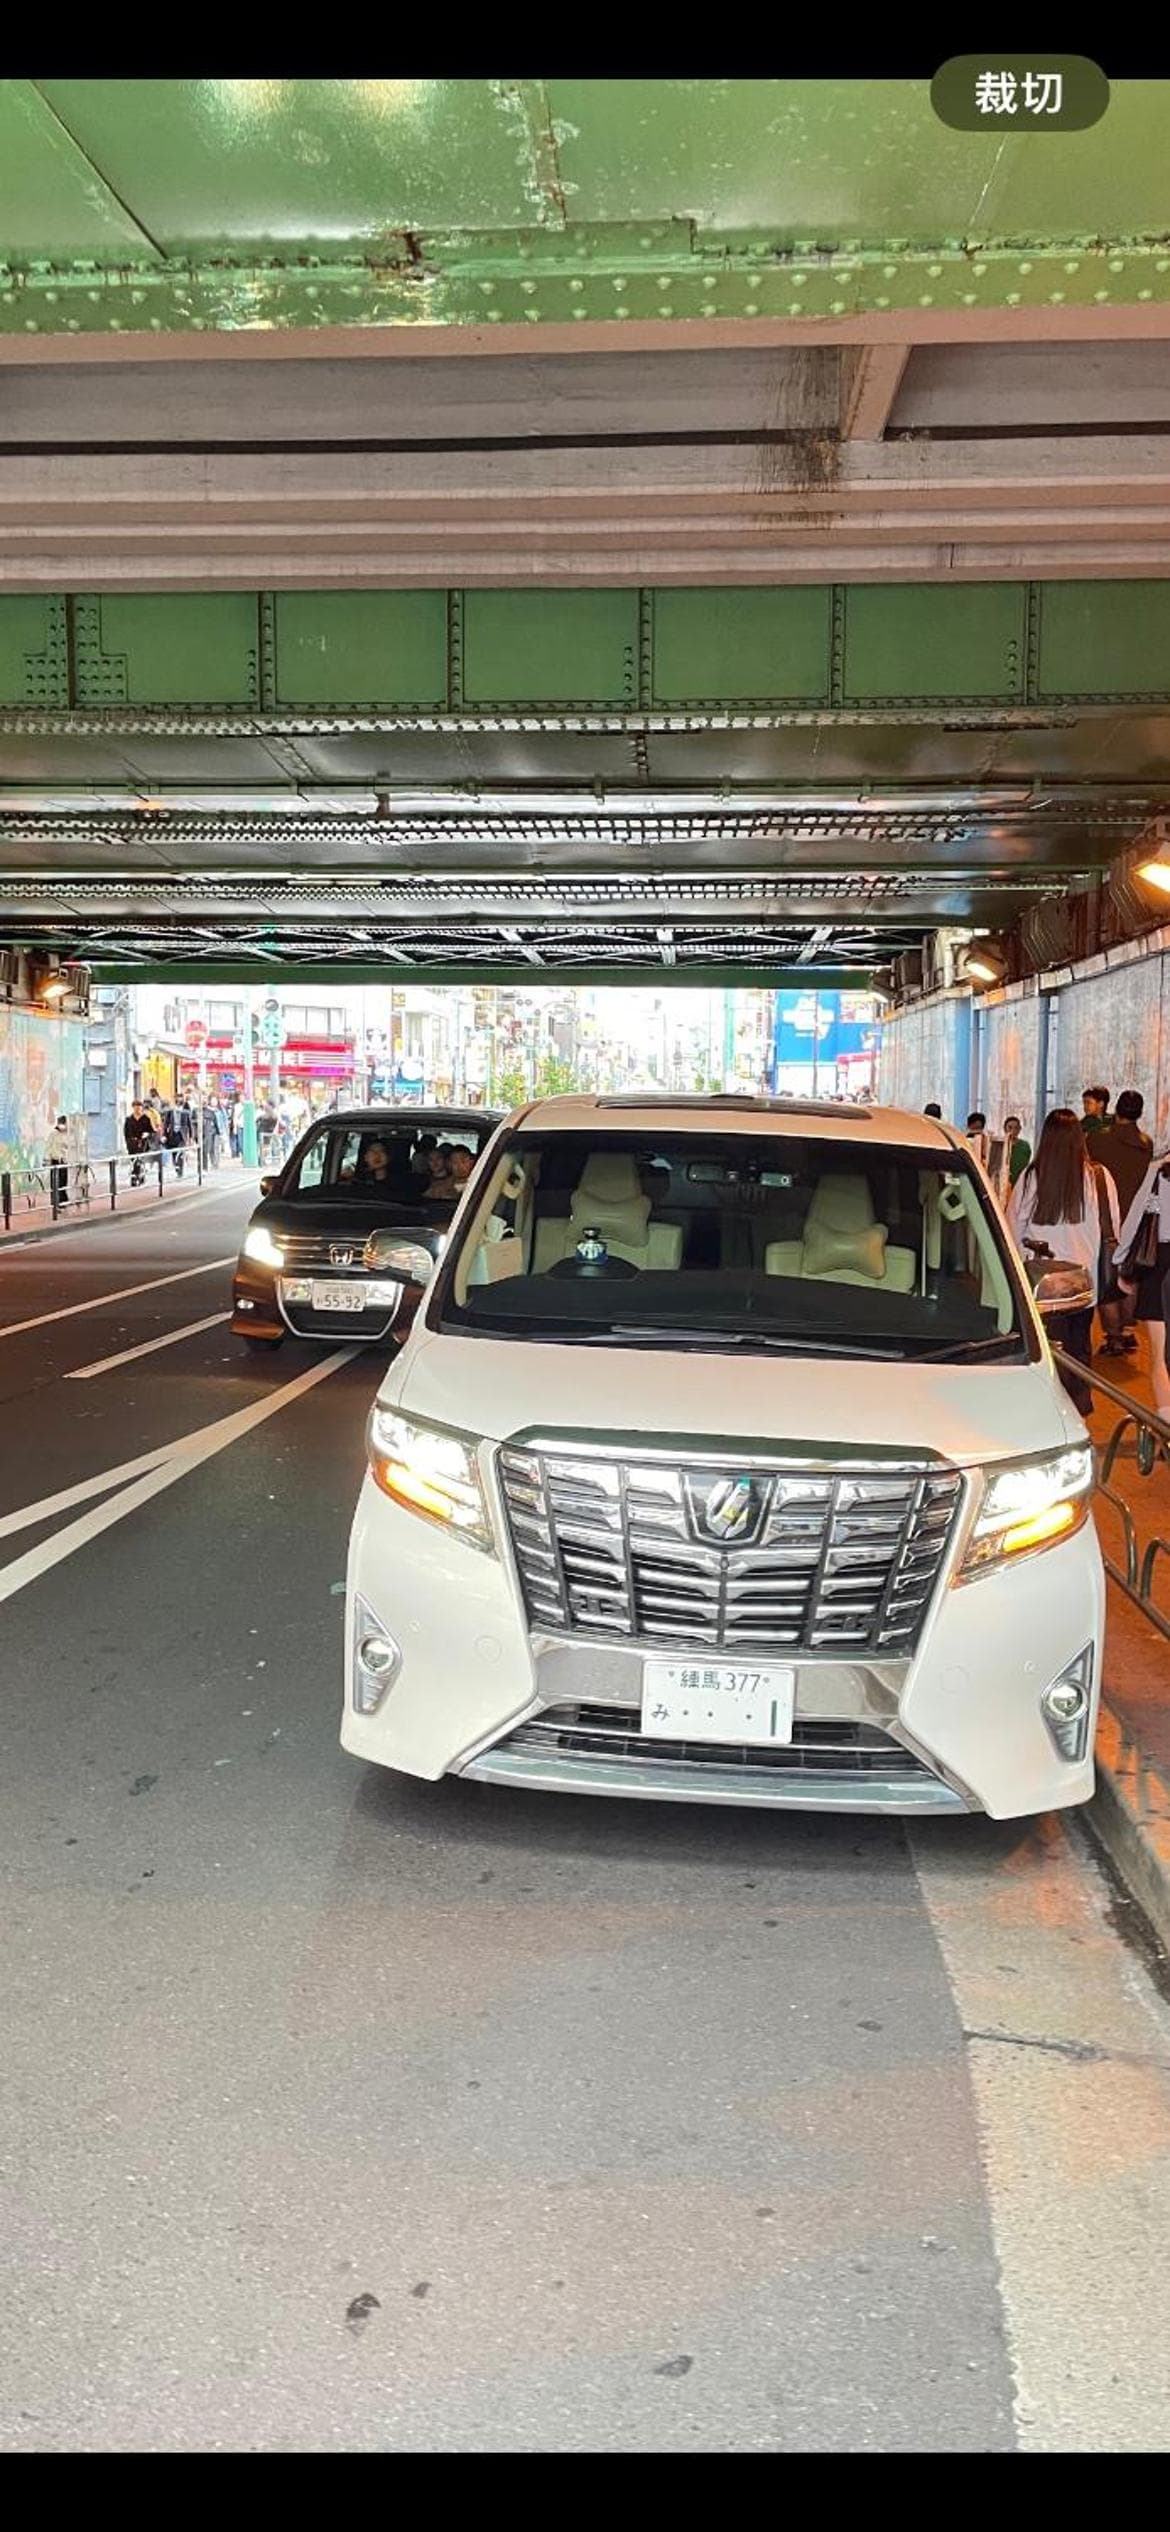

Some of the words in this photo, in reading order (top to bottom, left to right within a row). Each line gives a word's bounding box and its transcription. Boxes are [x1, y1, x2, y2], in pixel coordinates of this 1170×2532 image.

[680, 1669, 720, 1690] 練馬
[724, 1672, 761, 1693] 377
[651, 1703, 670, 1721] み
